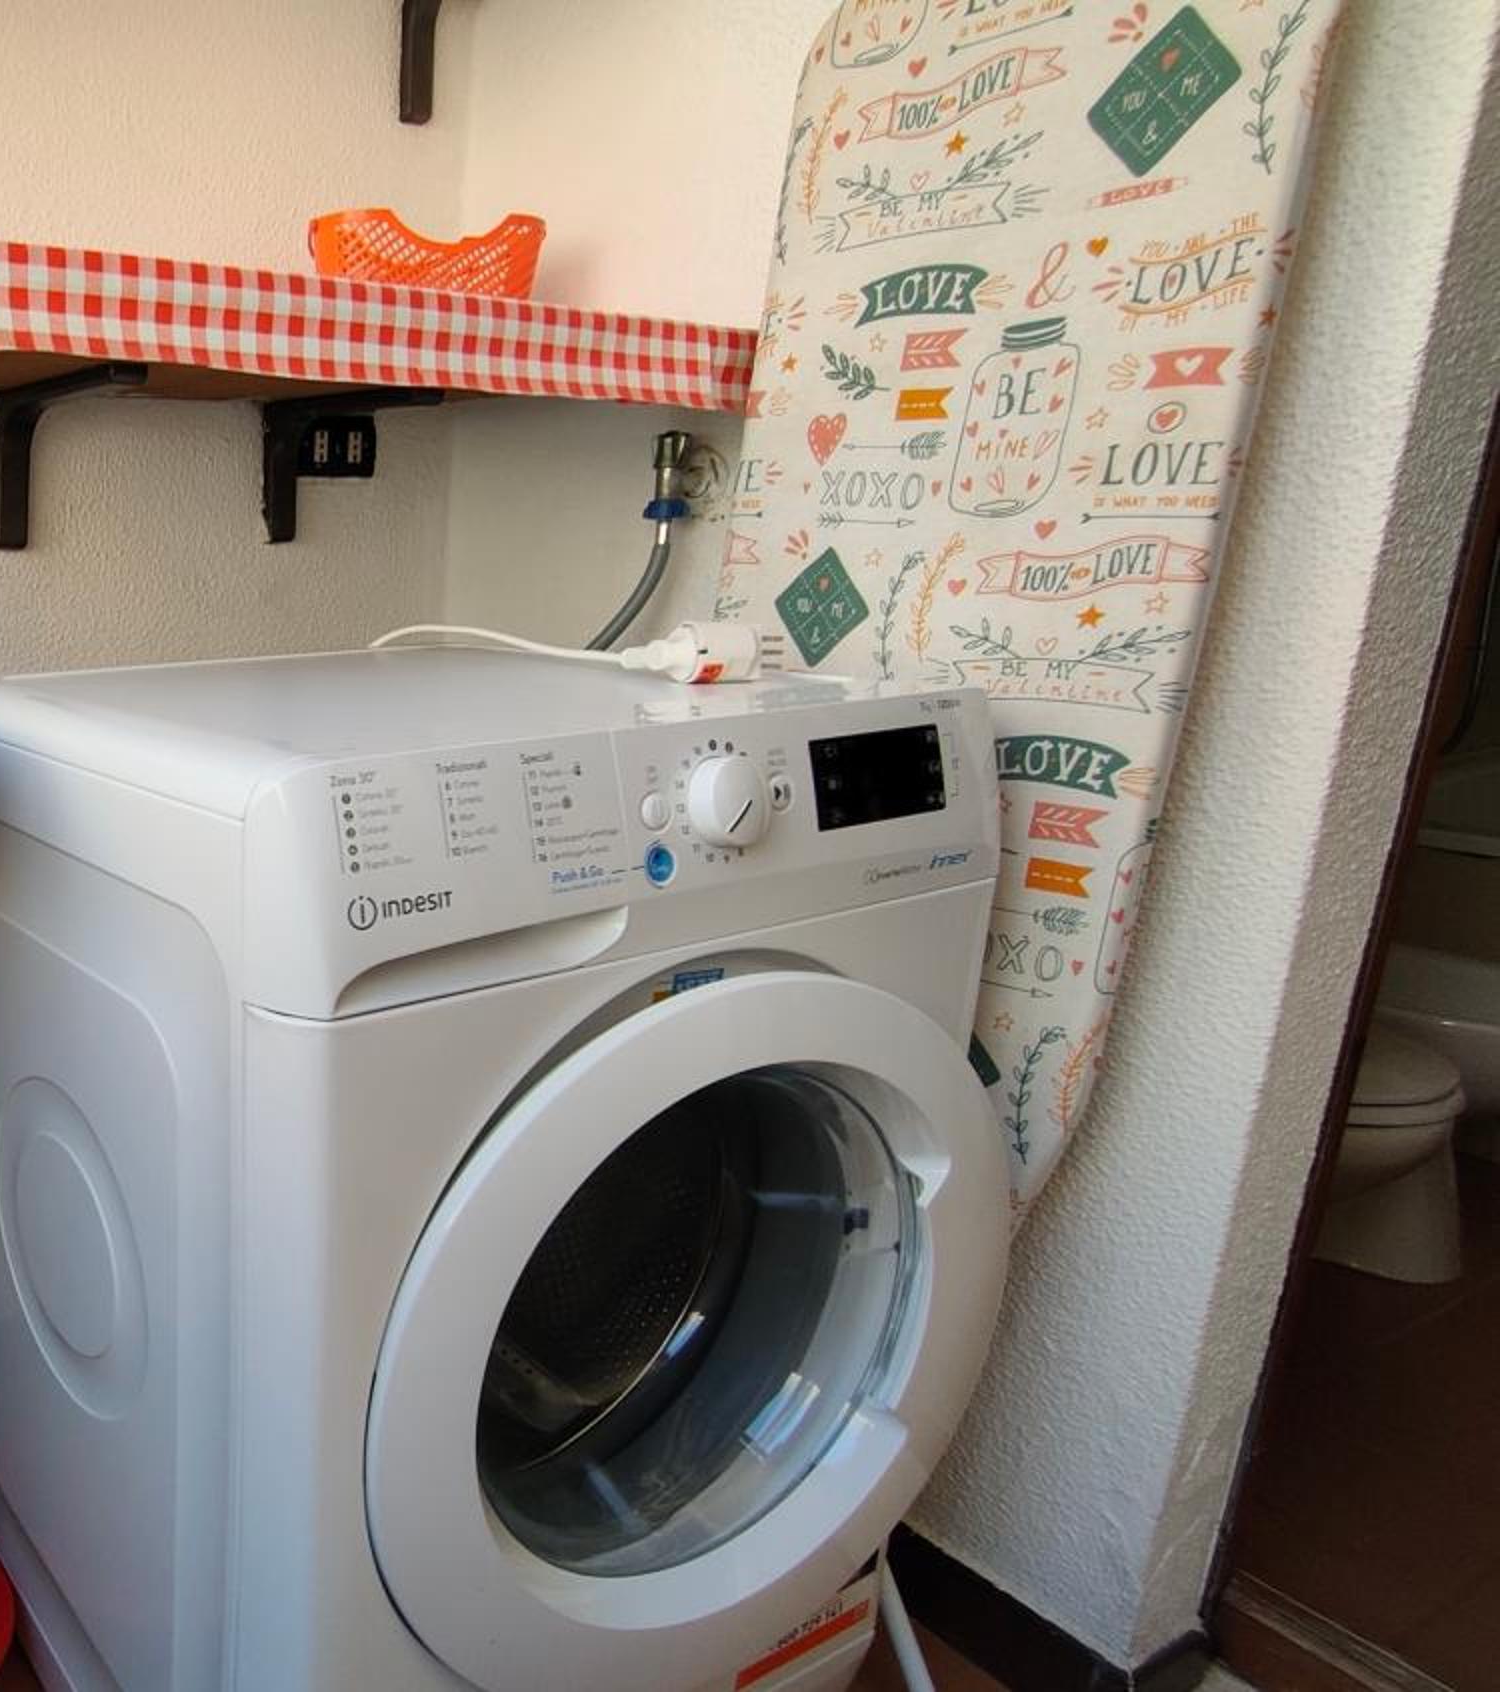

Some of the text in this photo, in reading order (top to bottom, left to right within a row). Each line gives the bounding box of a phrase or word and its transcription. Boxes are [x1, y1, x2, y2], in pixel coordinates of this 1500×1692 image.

[898, 95, 943, 131] 100%
[958, 57, 1016, 112] LOVE
[875, 270, 973, 318] LOVE
[1130, 237, 1255, 304] LOVE
[992, 367, 1046, 420] BE
[976, 436, 1029, 461] MINE
[1100, 441, 1225, 486] LOVE
[819, 470, 925, 511] XOXO
[1020, 562, 1074, 593] 100%
[1091, 543, 1157, 585] LOVE
[1000, 660, 1078, 681] BE MY
[998, 739, 1112, 793] LOVE
